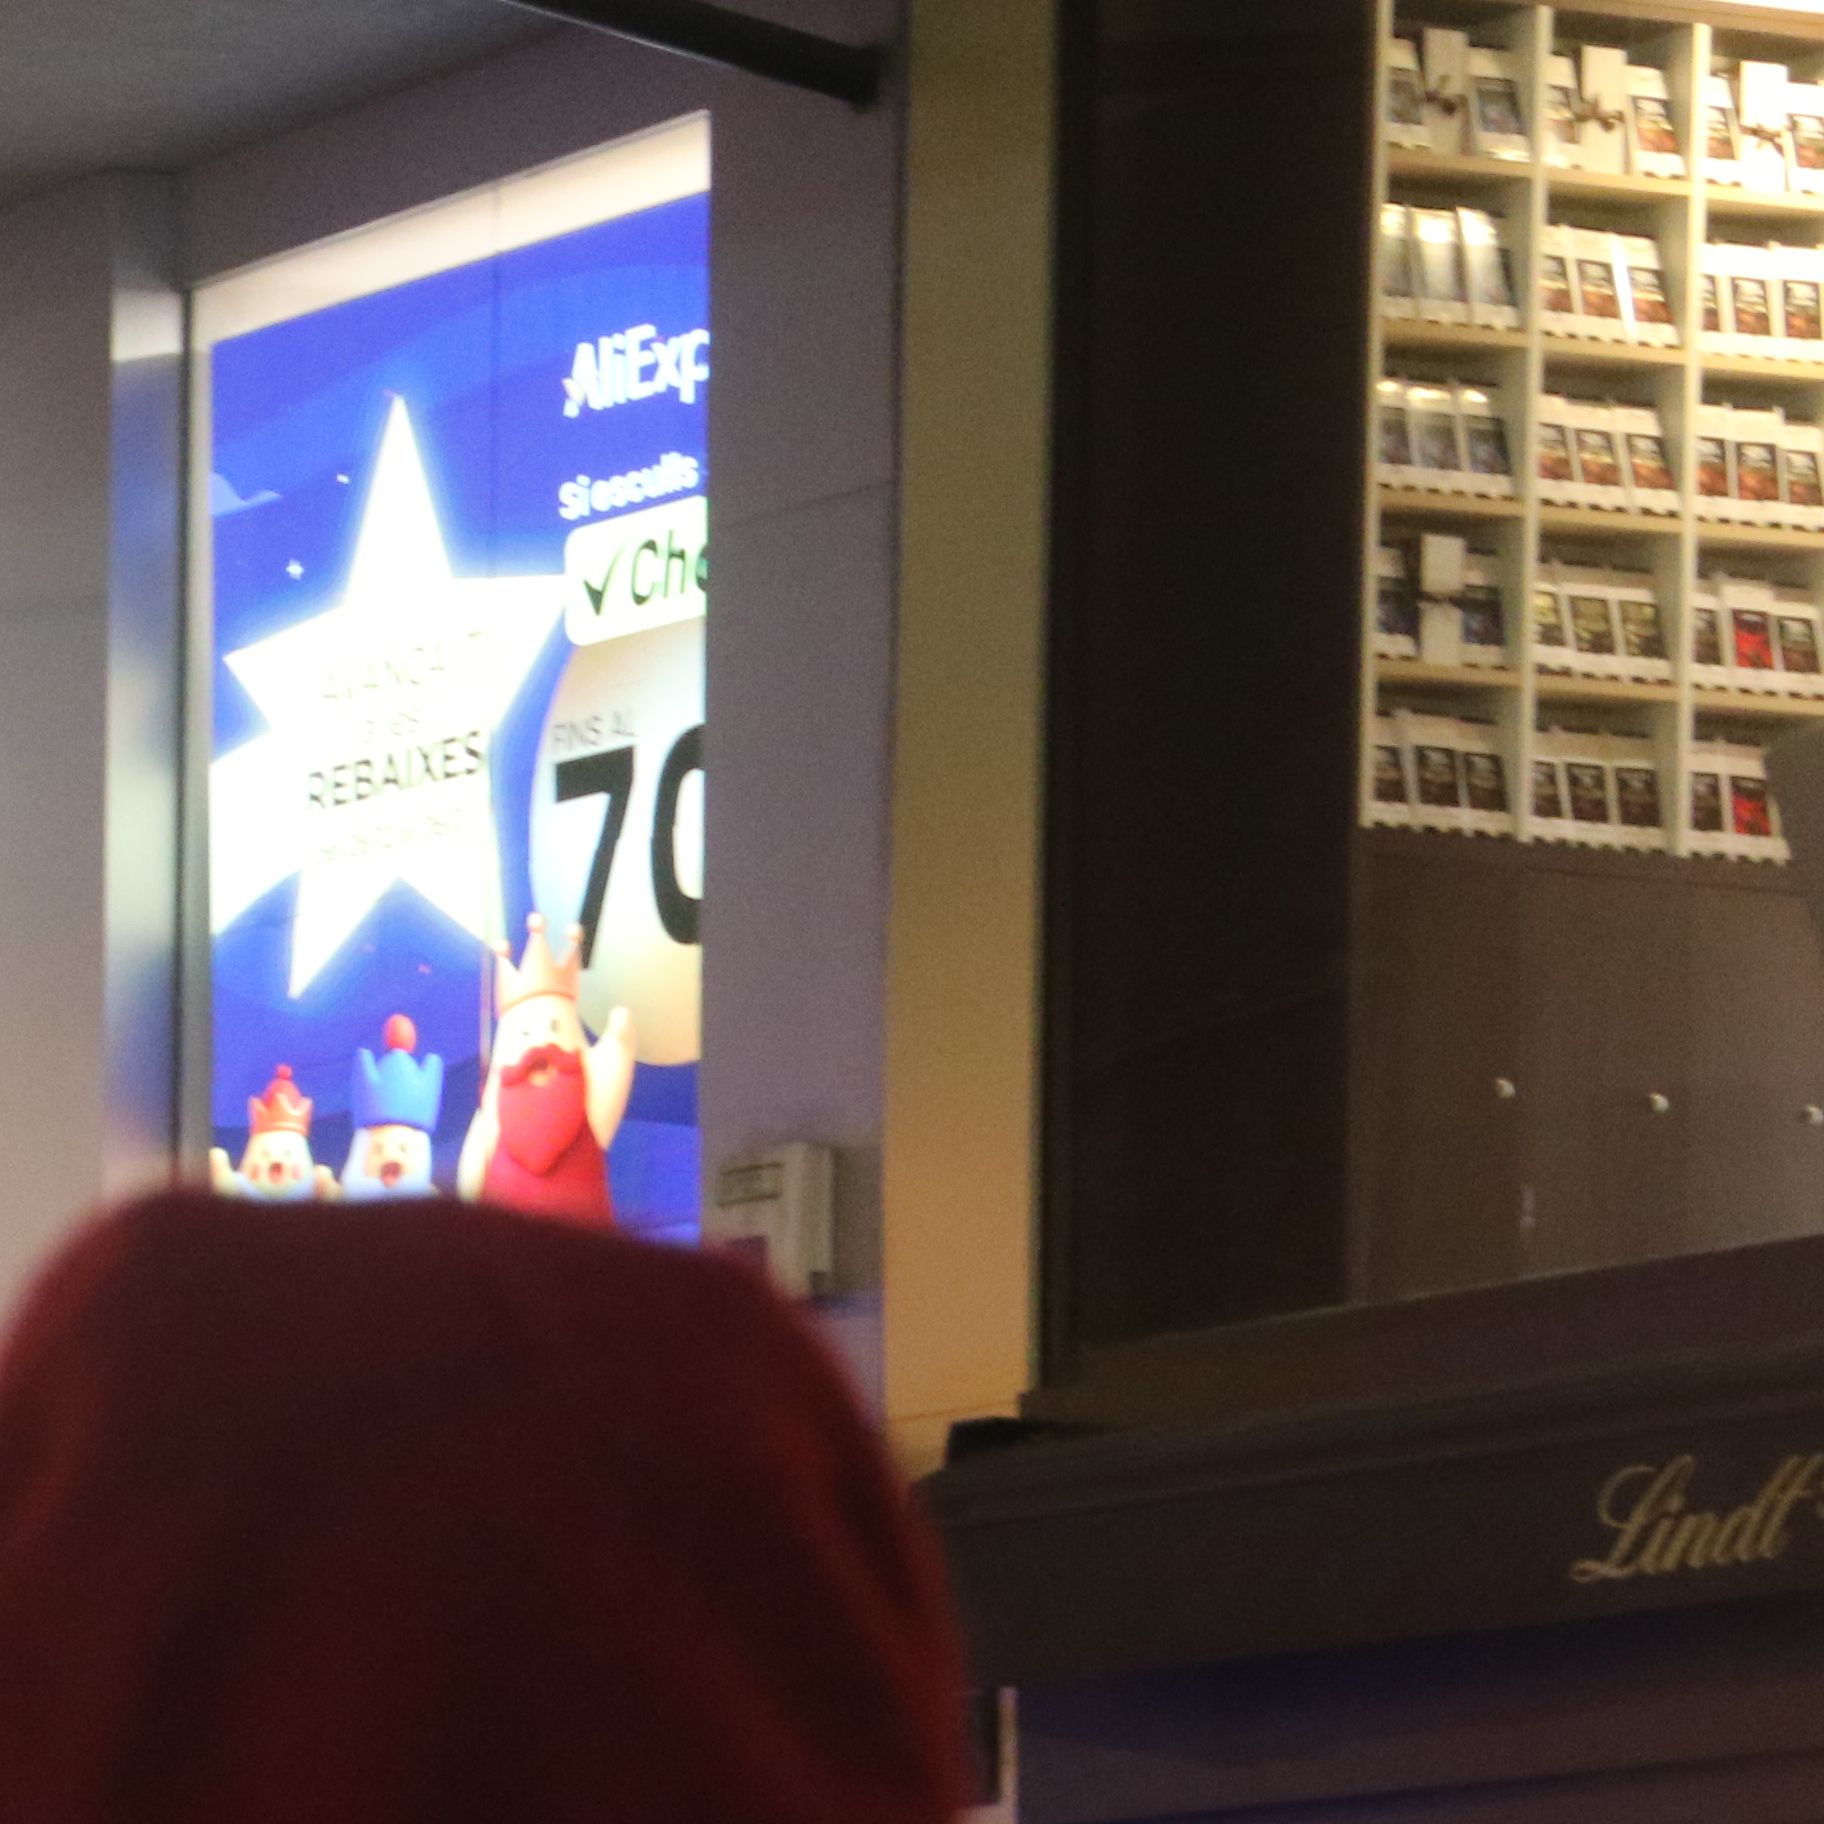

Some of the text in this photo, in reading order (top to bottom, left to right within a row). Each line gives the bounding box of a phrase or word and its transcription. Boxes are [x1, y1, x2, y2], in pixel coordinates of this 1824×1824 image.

[558, 474, 590, 520] Si
[308, 730, 486, 810] REBAIXES
[1568, 1452, 1824, 1583] Lindt
